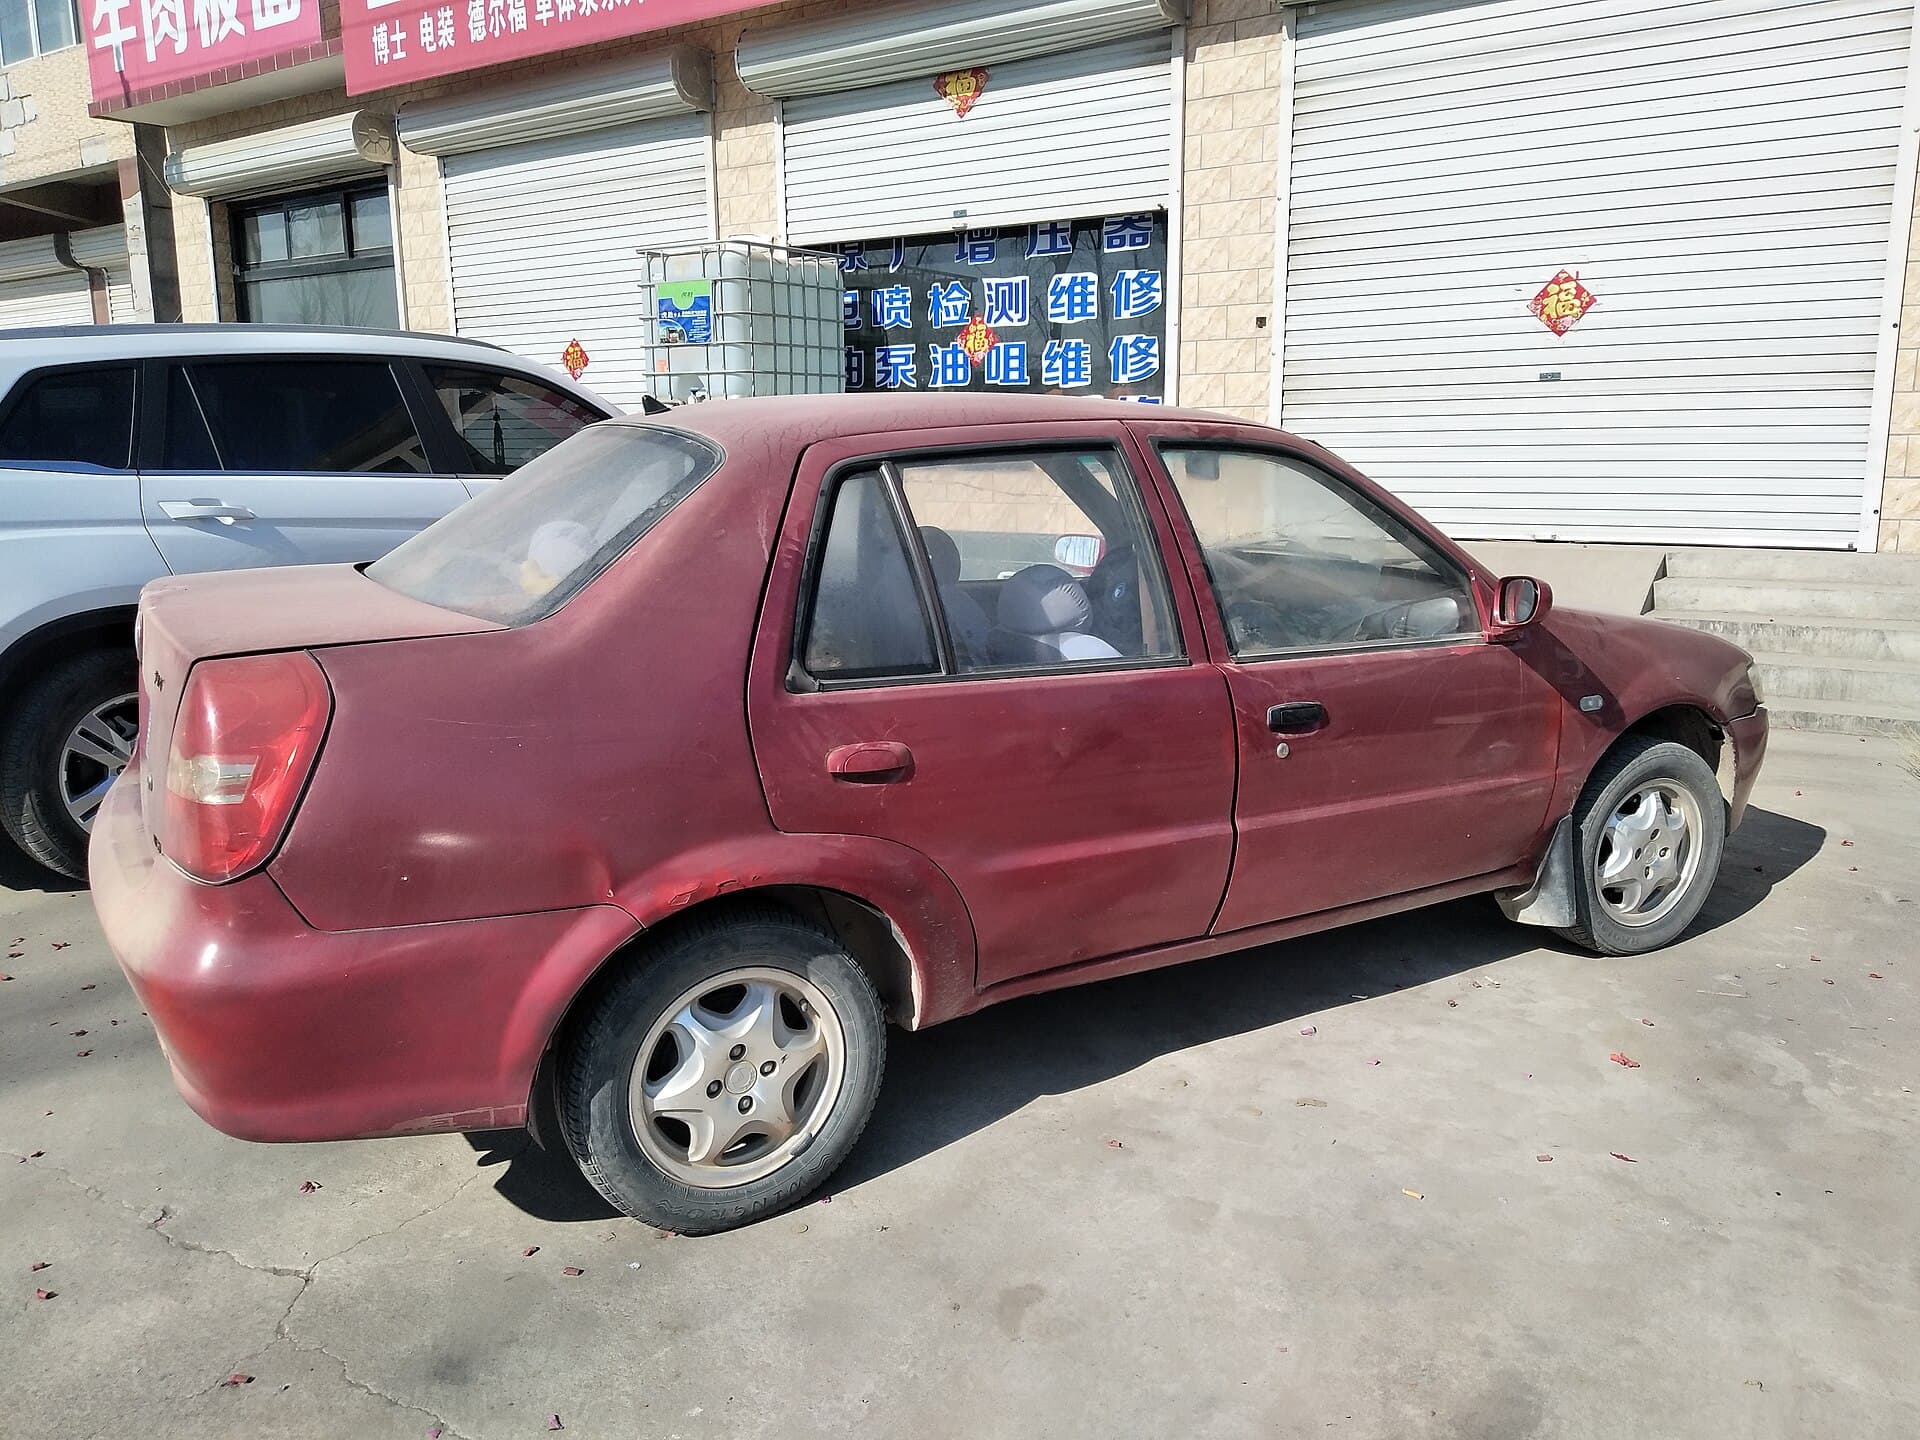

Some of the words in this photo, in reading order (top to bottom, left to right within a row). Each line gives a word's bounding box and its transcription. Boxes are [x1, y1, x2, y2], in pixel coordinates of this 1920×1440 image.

[371, 20, 407, 66] 博士
[419, 6, 456, 53] 电装
[467, 0, 528, 43] 德尔福
